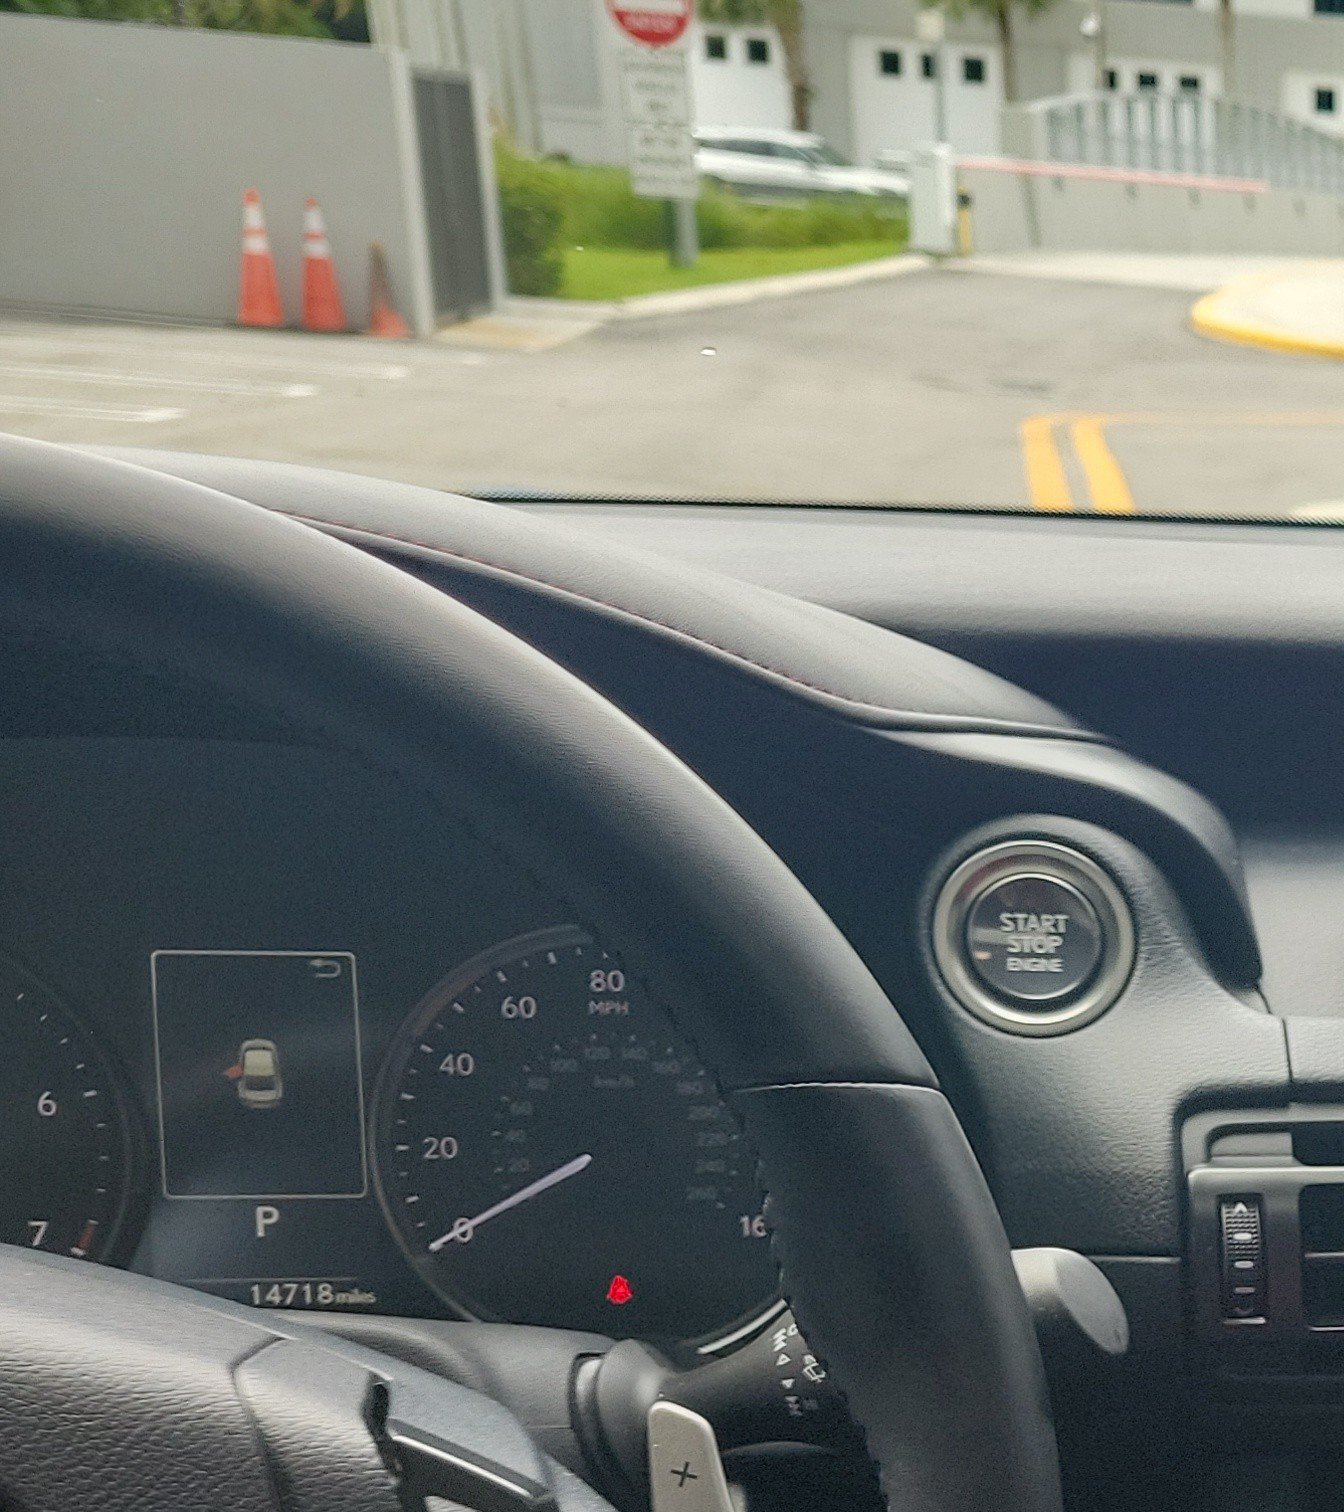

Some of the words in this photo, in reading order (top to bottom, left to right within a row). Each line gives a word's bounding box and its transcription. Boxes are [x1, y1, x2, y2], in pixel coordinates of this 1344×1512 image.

[999, 912, 1070, 934] START
[1007, 934, 1063, 954] STOP
[588, 969, 625, 994] 80
[500, 996, 537, 1020] 60
[588, 1000, 630, 1016] MPH
[439, 1052, 475, 1078] 40
[37, 1091, 57, 1117] 6
[422, 1136, 459, 1161] 20
[27, 1220, 49, 1247] 7
[255, 1206, 281, 1238] P
[452, 1216, 475, 1244] 0
[250, 1283, 334, 1307] 14718
